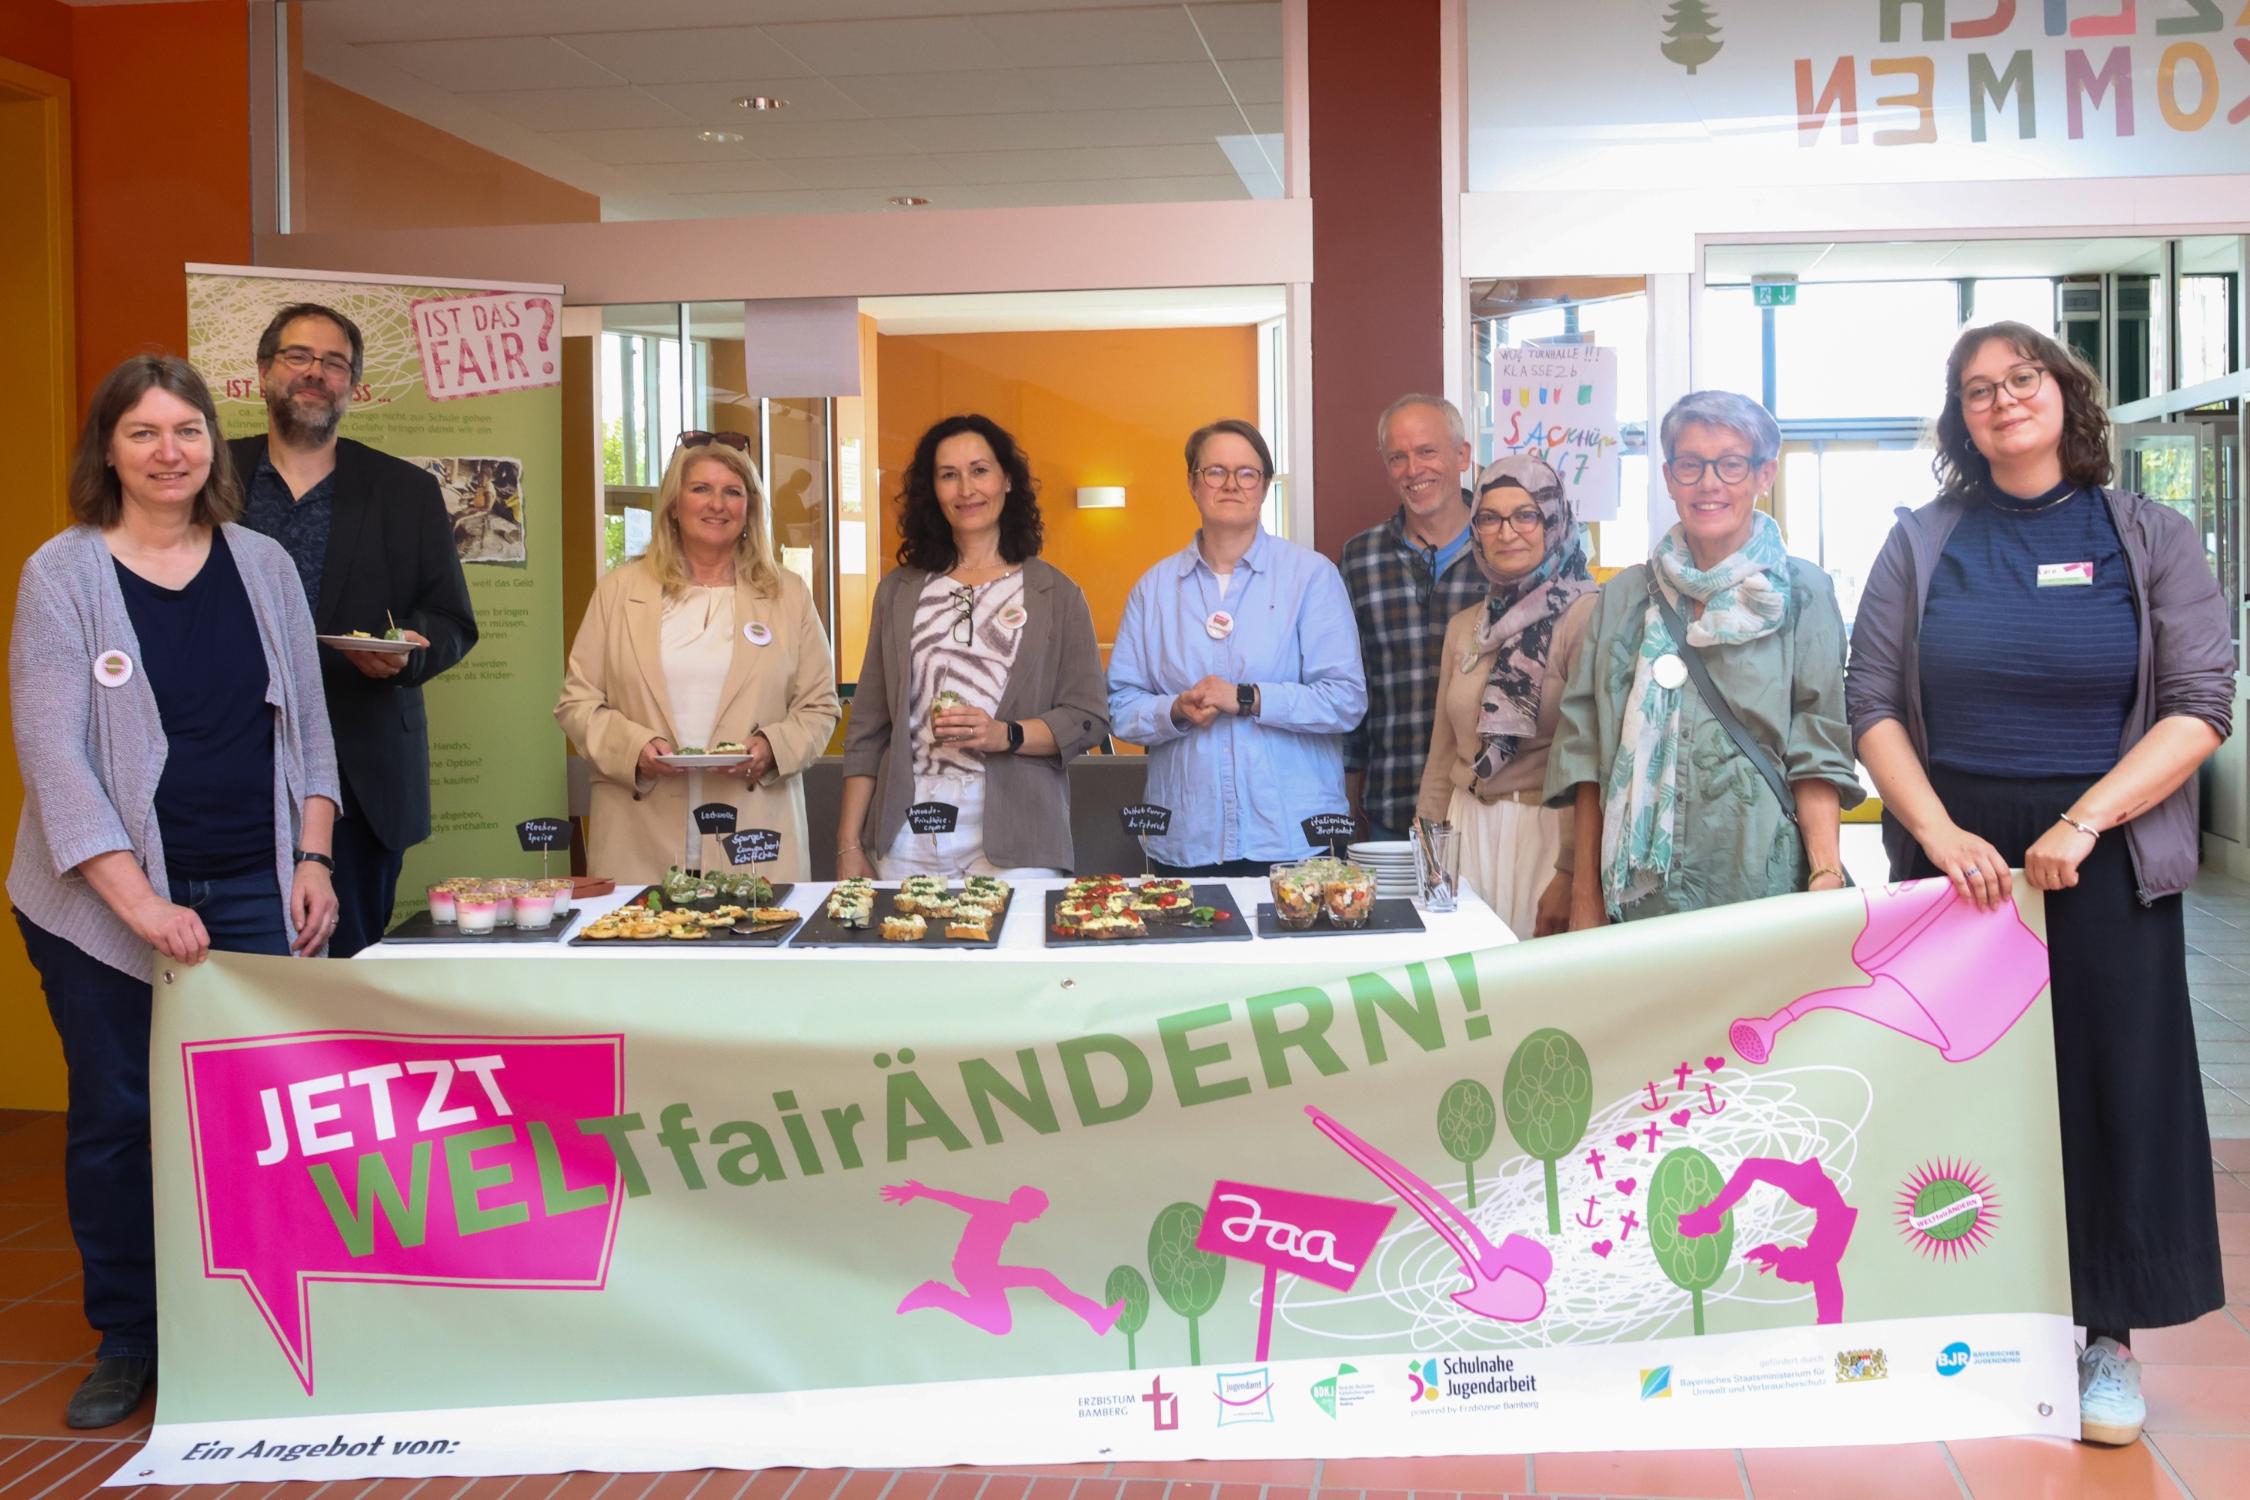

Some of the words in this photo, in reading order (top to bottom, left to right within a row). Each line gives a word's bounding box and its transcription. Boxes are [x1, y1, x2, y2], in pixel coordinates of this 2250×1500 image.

[424, 307, 461, 338] IST
[472, 300, 520, 332] DAS
[430, 332, 529, 389] FAIR
[1527, 347, 1579, 361] TURNHALLE
[226, 379, 252, 398] IST
[494, 578, 511, 588] das
[513, 578, 534, 588] Geld
[255, 1054, 514, 1167] JETZT
[1443, 1355, 1514, 1376] Schulnahe
[1937, 1351, 1969, 1367] BJR
[1225, 1380, 1263, 1394] jugendamt
[1445, 1375, 1537, 1399] Jugendarbeit
[1077, 1393, 1137, 1408] ERZBISTUM
[1077, 1406, 1129, 1418] BAMBERG
[181, 1440, 235, 1461] Ein
[237, 1435, 385, 1462] Angebot
[391, 1438, 461, 1456] von:
